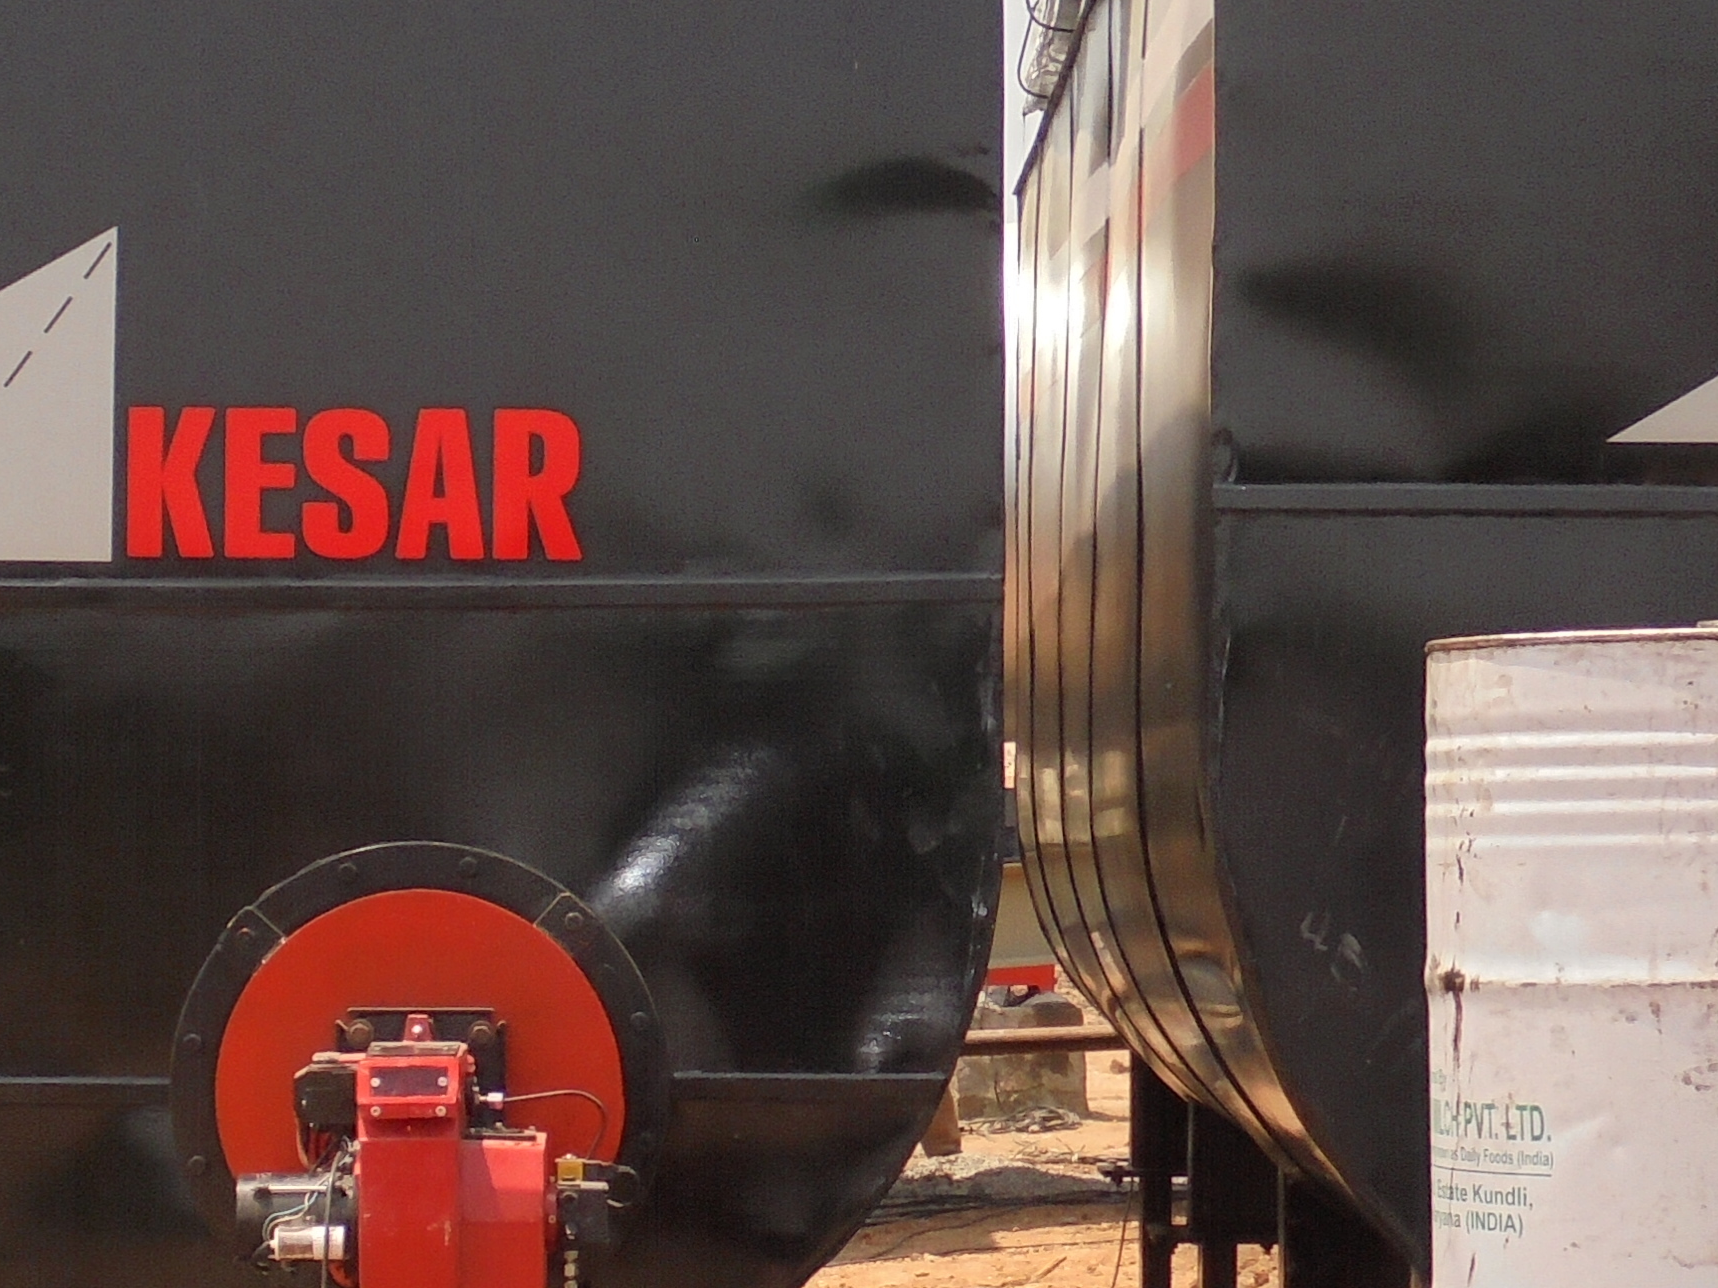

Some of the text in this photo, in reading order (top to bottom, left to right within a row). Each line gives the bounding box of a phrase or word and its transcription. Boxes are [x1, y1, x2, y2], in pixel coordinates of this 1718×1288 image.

[124, 404, 584, 562] KESAR
[1463, 1100, 1499, 1140] PVT.
[1505, 1103, 1552, 1142] LTD.
[1483, 1148, 1514, 1165] Foods
[1517, 1150, 1554, 1171] (India)
[1472, 1183, 1533, 1211] Kundli,
[1465, 1210, 1523, 1239] (INDIA)
